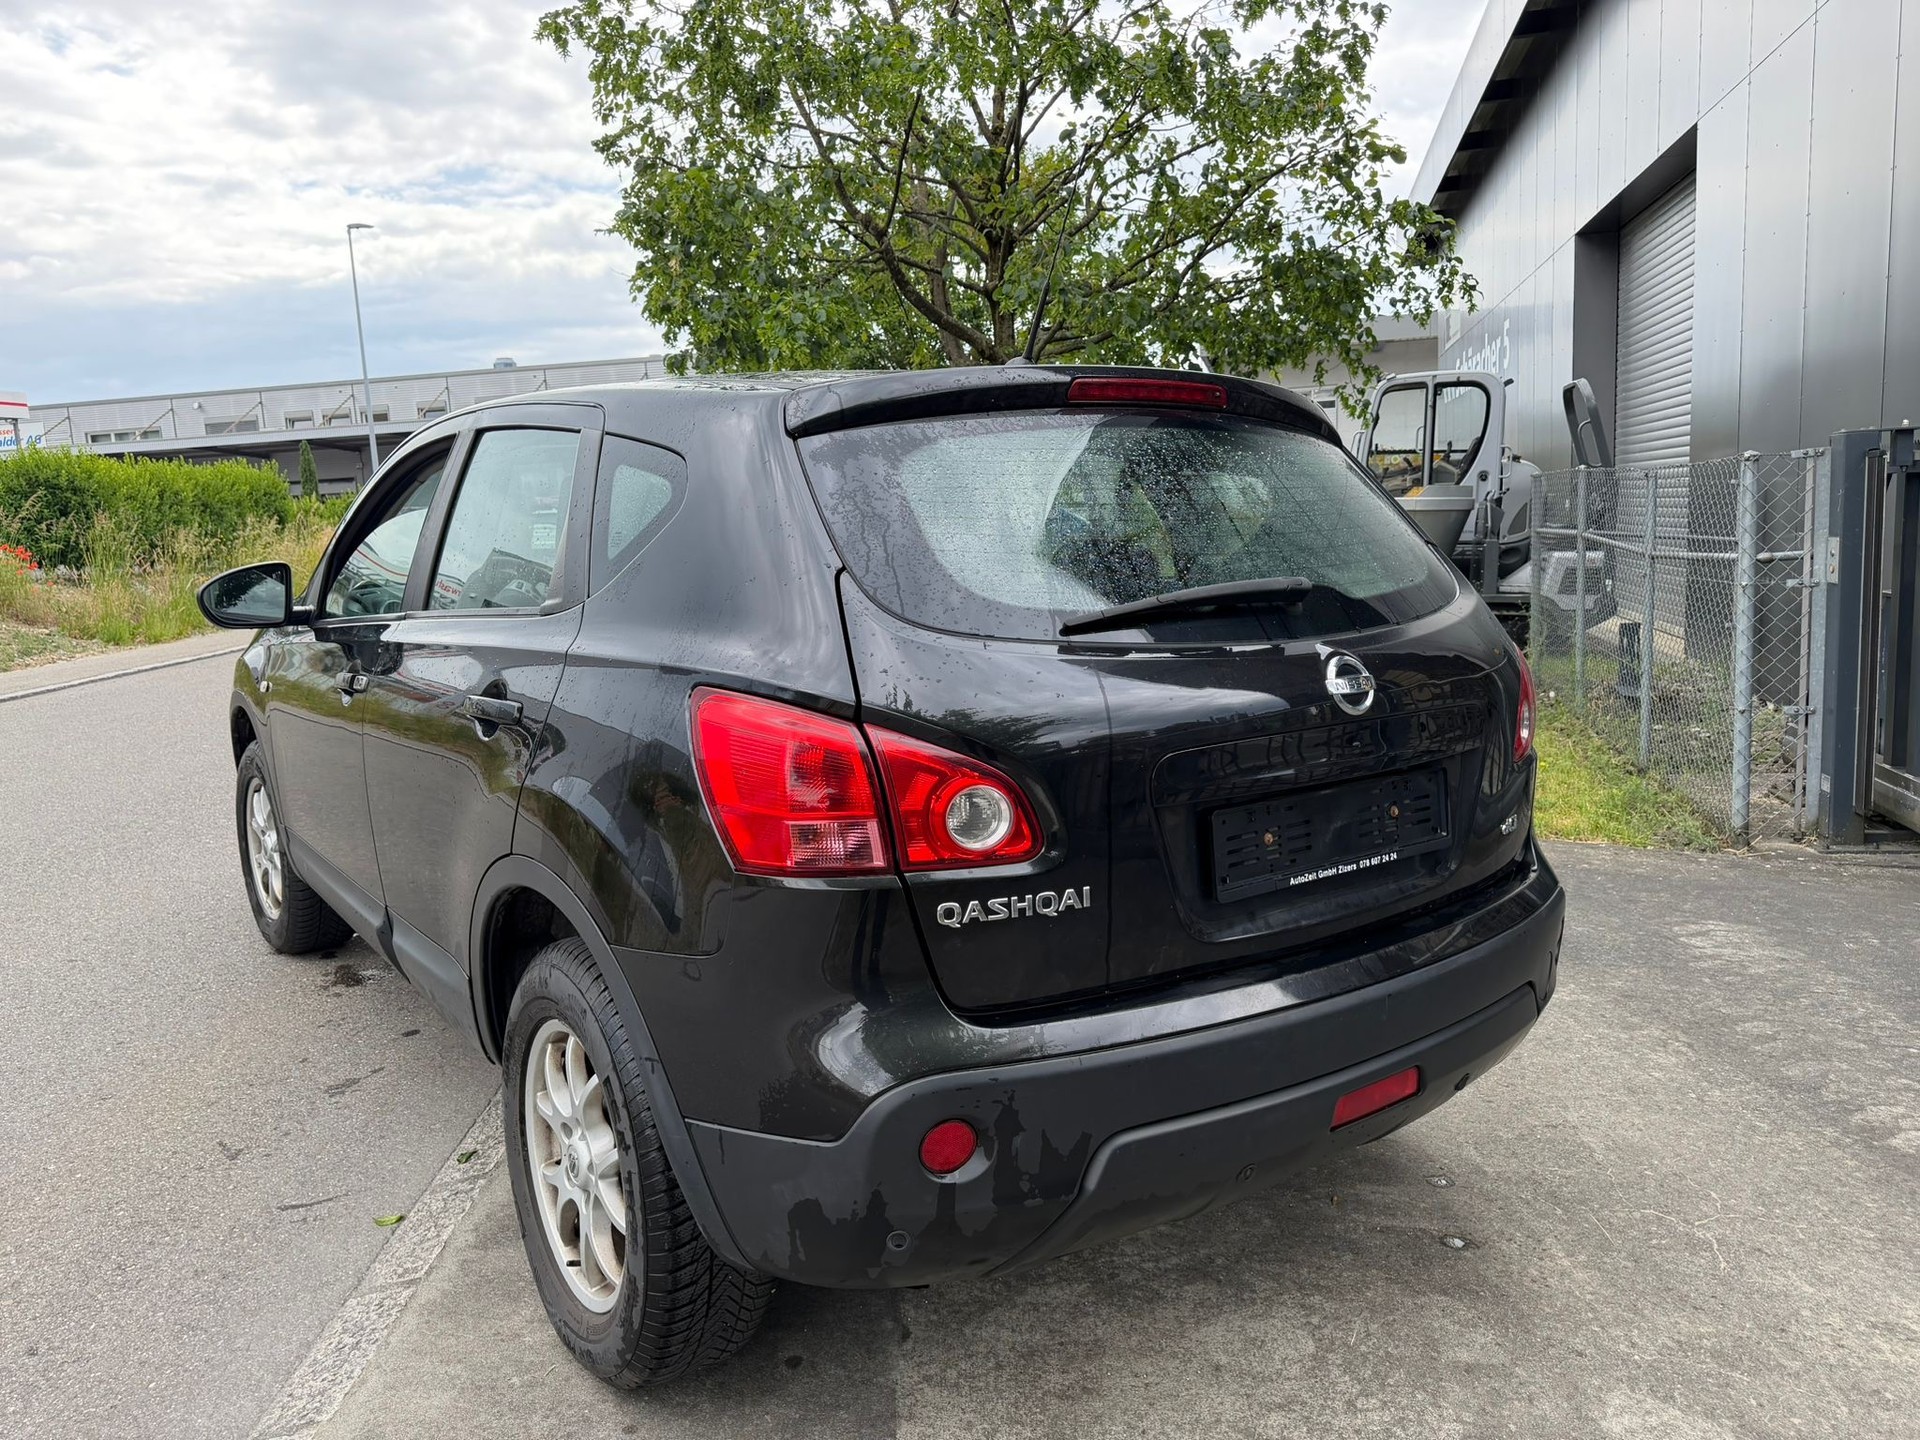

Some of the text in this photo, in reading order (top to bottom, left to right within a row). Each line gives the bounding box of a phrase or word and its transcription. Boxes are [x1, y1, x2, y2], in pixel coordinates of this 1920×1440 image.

[1503, 318, 1510, 370] 5
[1334, 676, 1373, 691] NISSAN
[1290, 872, 1317, 886] AutoZeit
[1318, 866, 1337, 879] GmbH
[1338, 863, 1357, 873] Zizers
[1382, 854, 1389, 863] 24
[1390, 852, 1397, 860] 24
[936, 885, 1091, 928] QASHQAI
